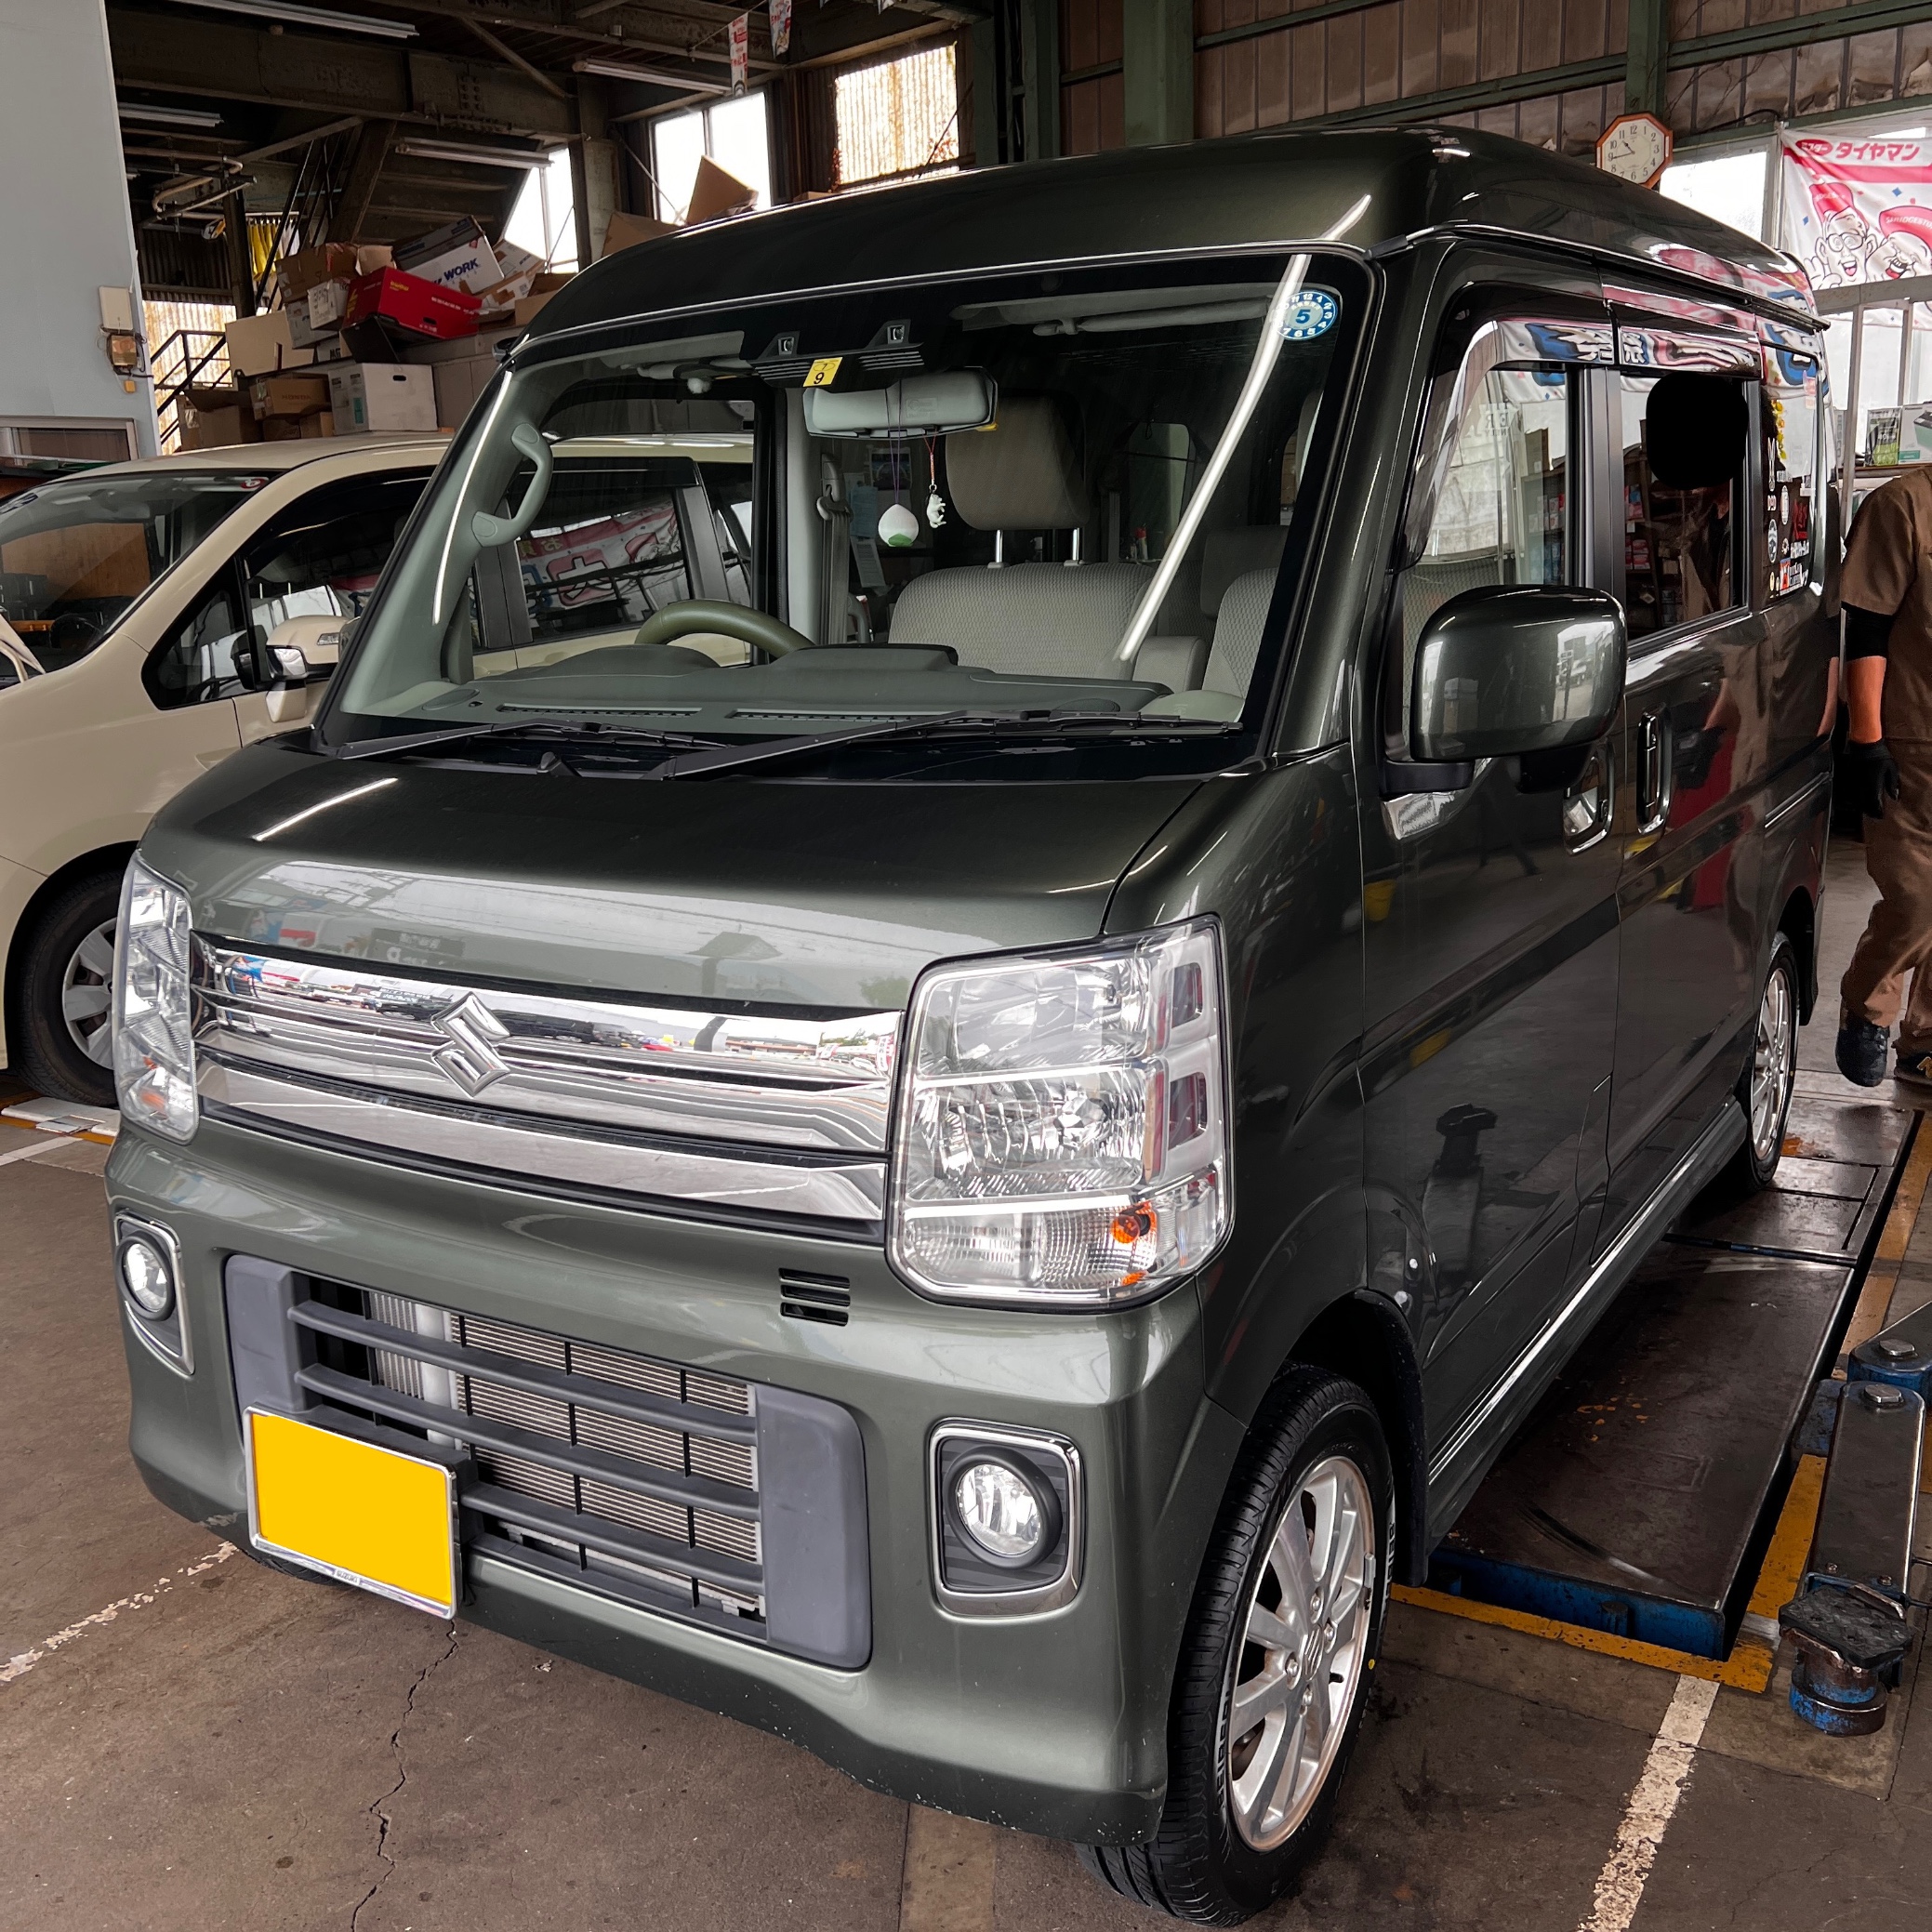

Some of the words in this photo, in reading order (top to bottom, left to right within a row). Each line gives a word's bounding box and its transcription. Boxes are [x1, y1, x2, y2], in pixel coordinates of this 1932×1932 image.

[1619, 130, 1625, 139] 11
[1630, 126, 1637, 135] 12
[1644, 126, 1647, 135] 1
[1650, 133, 1657, 141] 2
[1610, 140, 1617, 149] 10
[1653, 145, 1660, 154] 3
[1835, 142, 1921, 161] タイヤマン
[1608, 152, 1614, 161] 9
[1650, 158, 1656, 166] 4
[1611, 165, 1617, 173] 8
[1643, 167, 1648, 177] 5
[1631, 171, 1636, 180] 6
[443, 258, 479, 281] WORK
[1295, 309, 1311, 324] 5
[814, 372, 825, 384] 9
